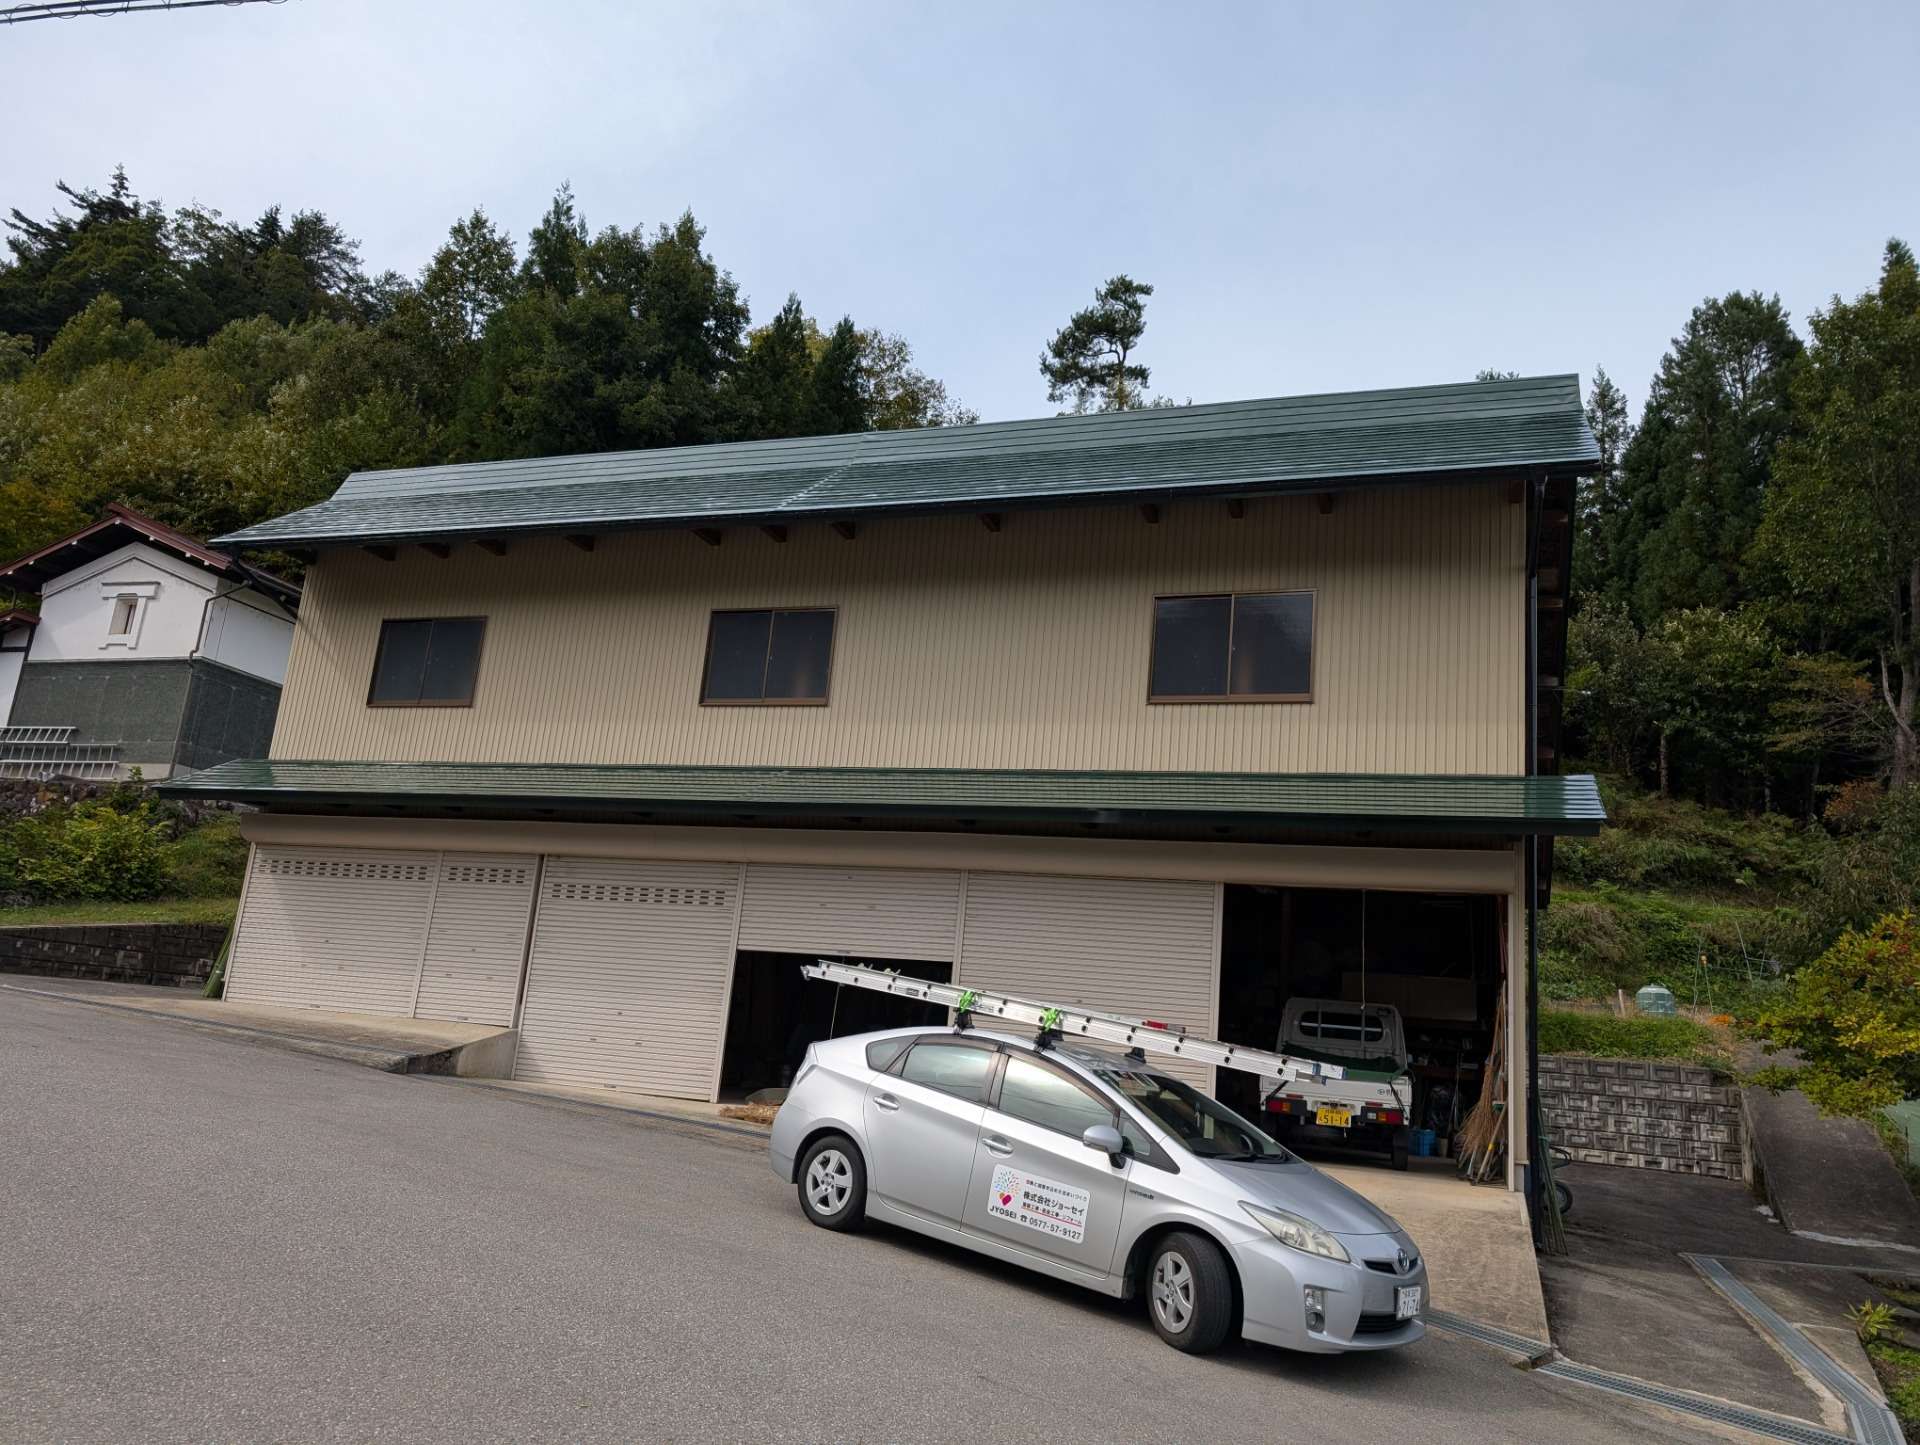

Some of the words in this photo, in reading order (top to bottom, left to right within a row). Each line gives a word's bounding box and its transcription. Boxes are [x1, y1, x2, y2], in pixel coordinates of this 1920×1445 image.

[989, 1205, 1017, 1219] JYOSEI
[1023, 1191, 1085, 1216] 株式会社ジョーセイ
[1029, 1217, 1081, 1240] 0577-57-9127
